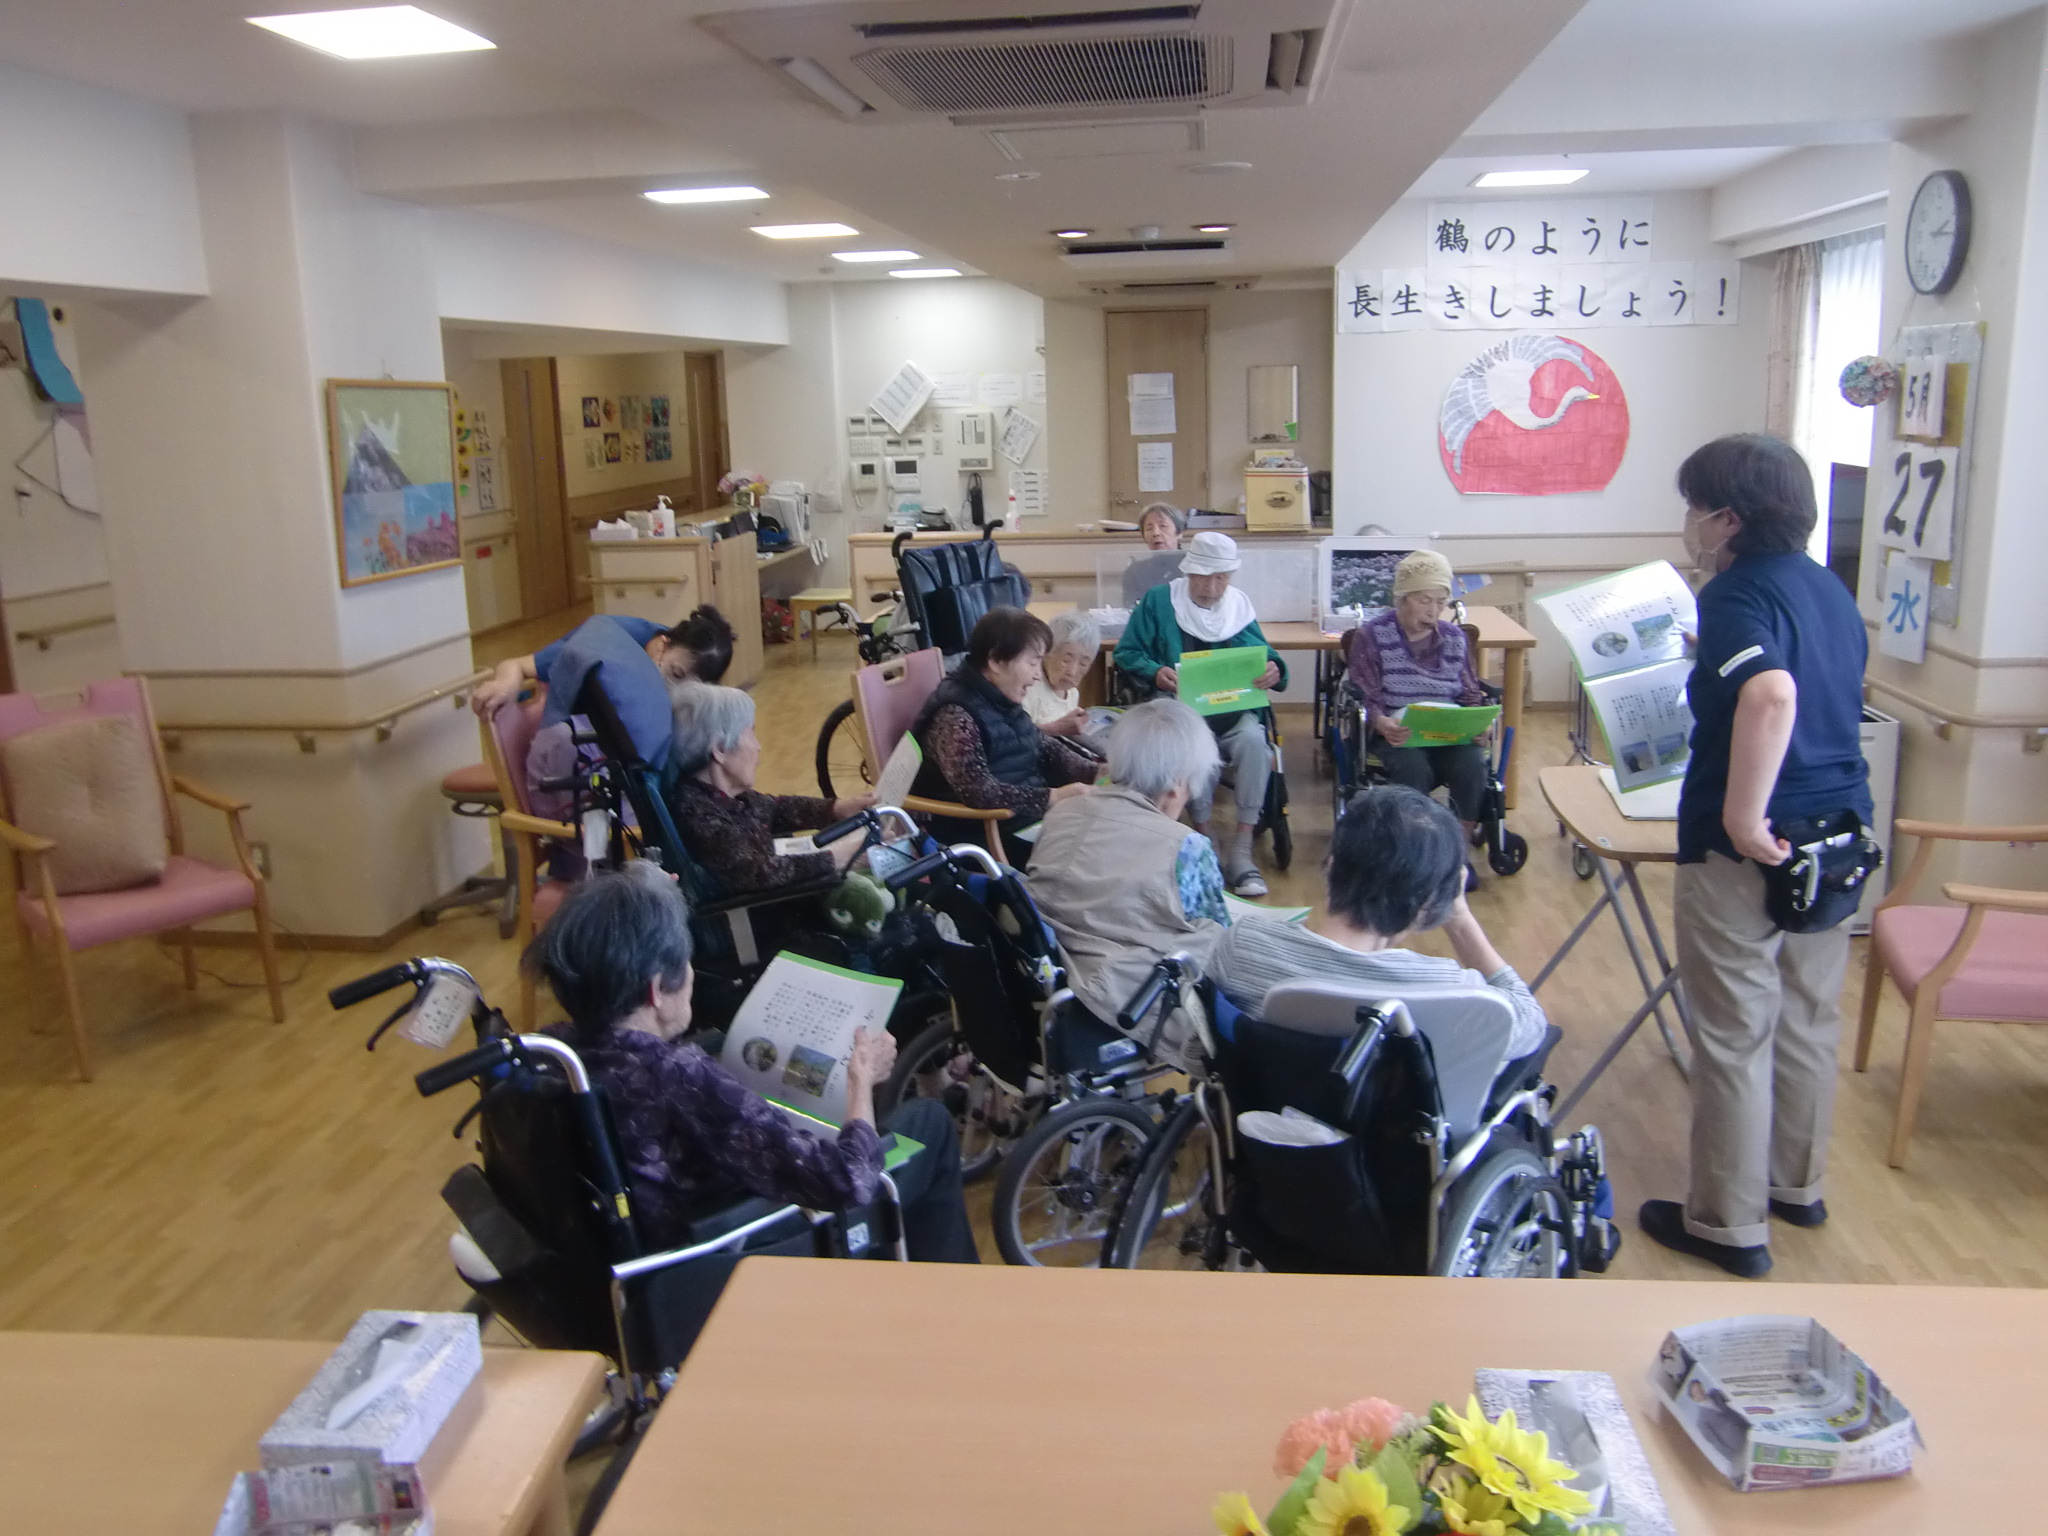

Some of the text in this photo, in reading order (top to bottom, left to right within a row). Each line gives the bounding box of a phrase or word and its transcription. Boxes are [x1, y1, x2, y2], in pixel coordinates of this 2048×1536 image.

[1434, 217, 1650, 256] 鶴のように
[1347, 277, 1728, 320] 長生きしましょう！
[1884, 451, 1945, 548] 27
[1886, 579, 1921, 634] 水
